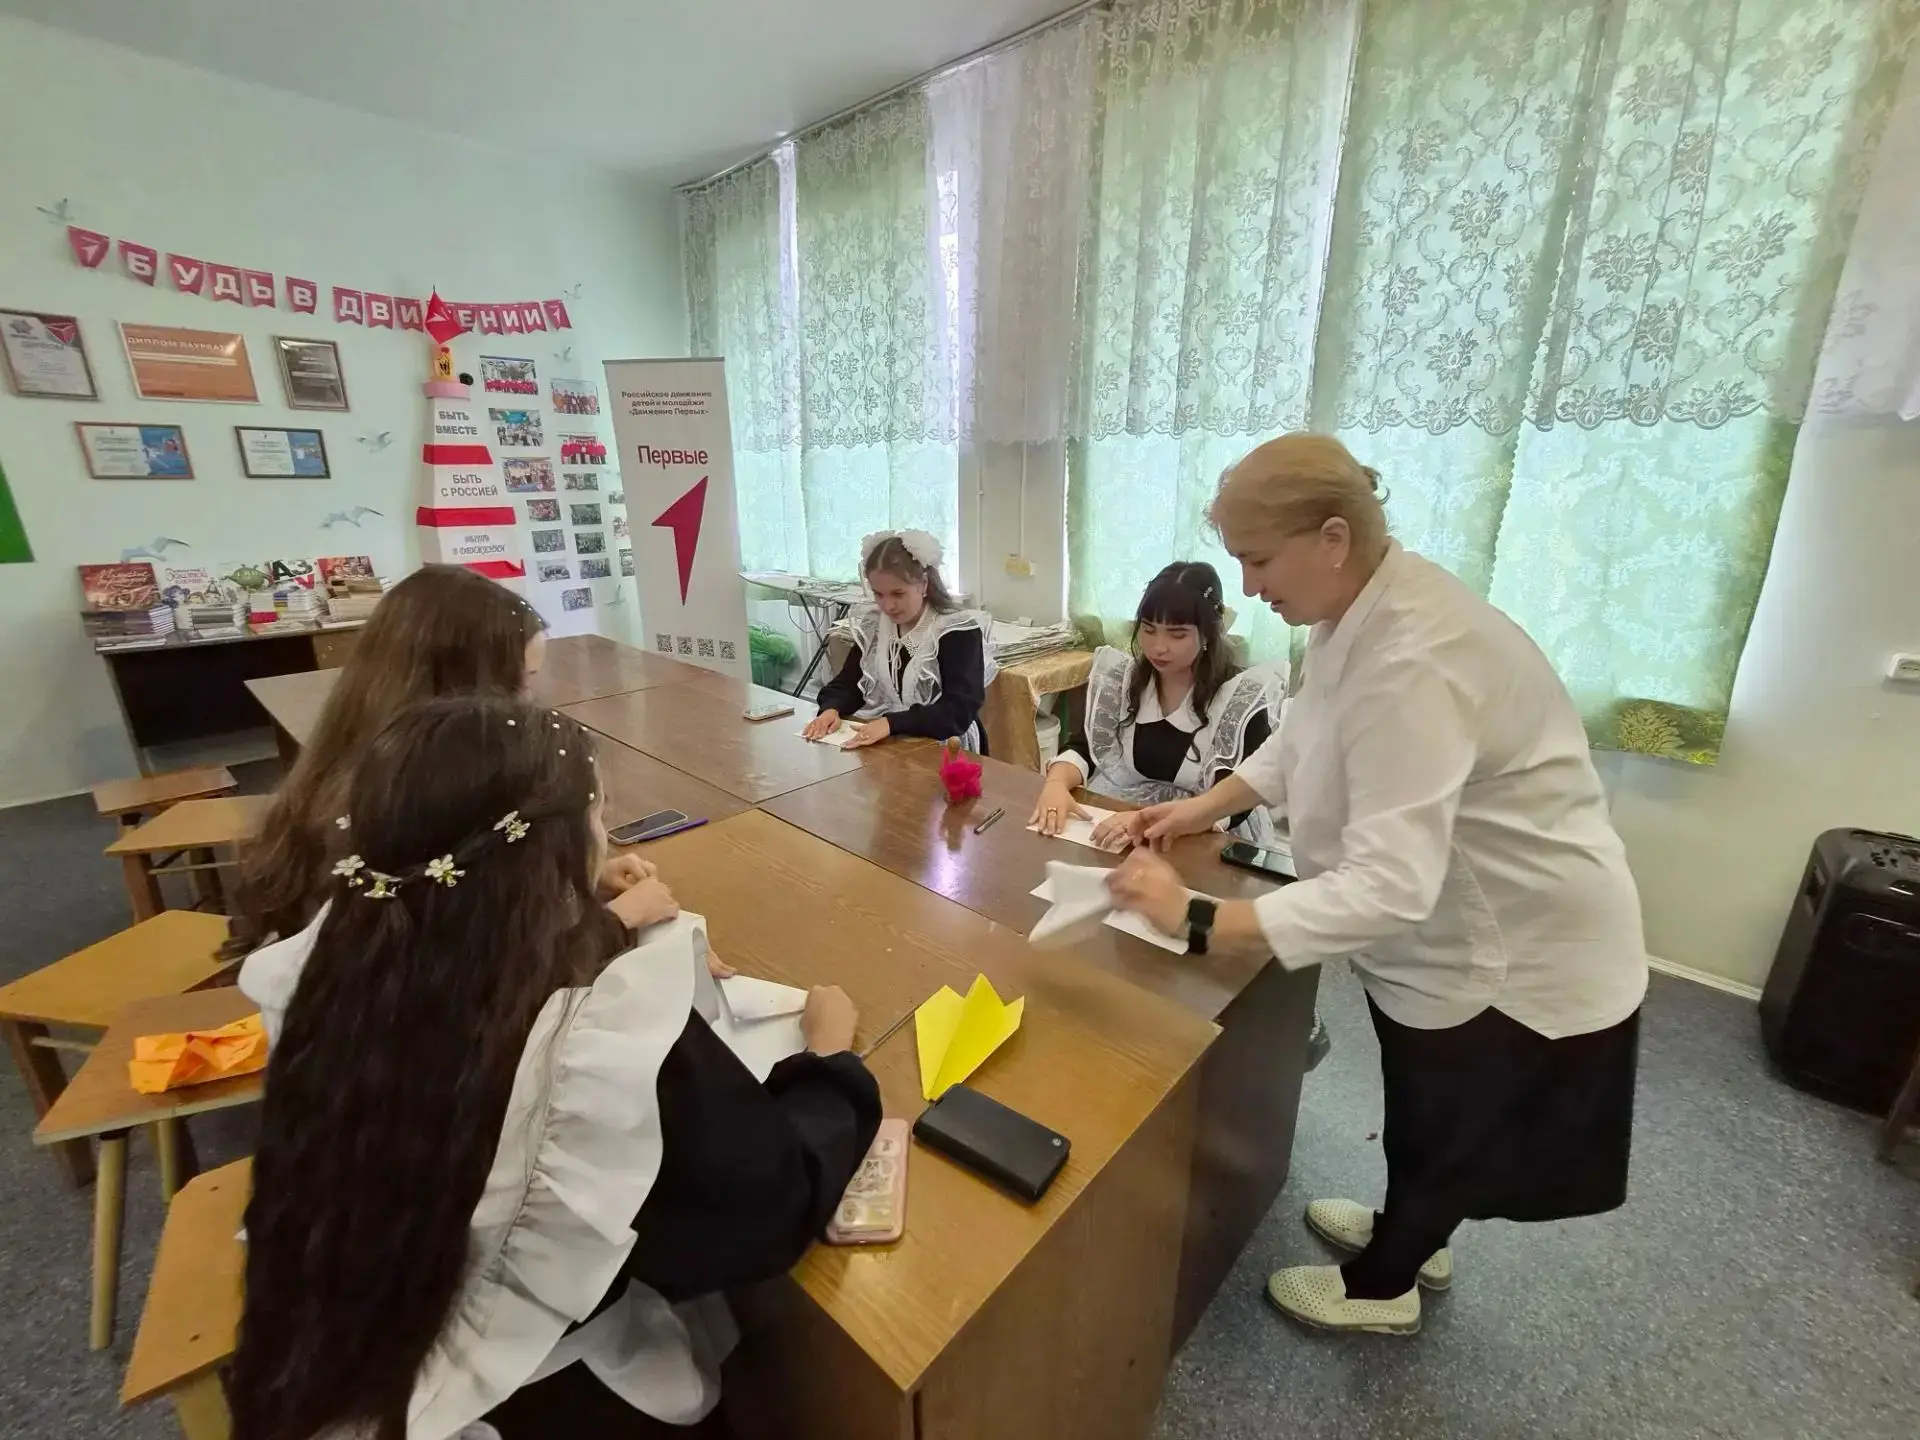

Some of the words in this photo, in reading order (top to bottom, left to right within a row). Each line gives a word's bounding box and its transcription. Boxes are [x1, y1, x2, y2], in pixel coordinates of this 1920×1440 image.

[126, 251, 273, 300] БУДЬ
[293, 286, 314, 307] В
[338, 296, 545, 328] ДВИЕНИИ
[128, 336, 177, 347] ДИПЛОМ
[621, 391, 669, 399] Российское
[670, 391, 713, 399] движение
[631, 399, 655, 407] детей
[438, 411, 470, 421] БЫТЬ
[436, 426, 478, 436] ВМЕСТЕ
[638, 445, 708, 470] Первые
[452, 474, 482, 484] БЫТЬ
[441, 488, 449, 497] С
[451, 485, 499, 497] РОССИЕЙ
